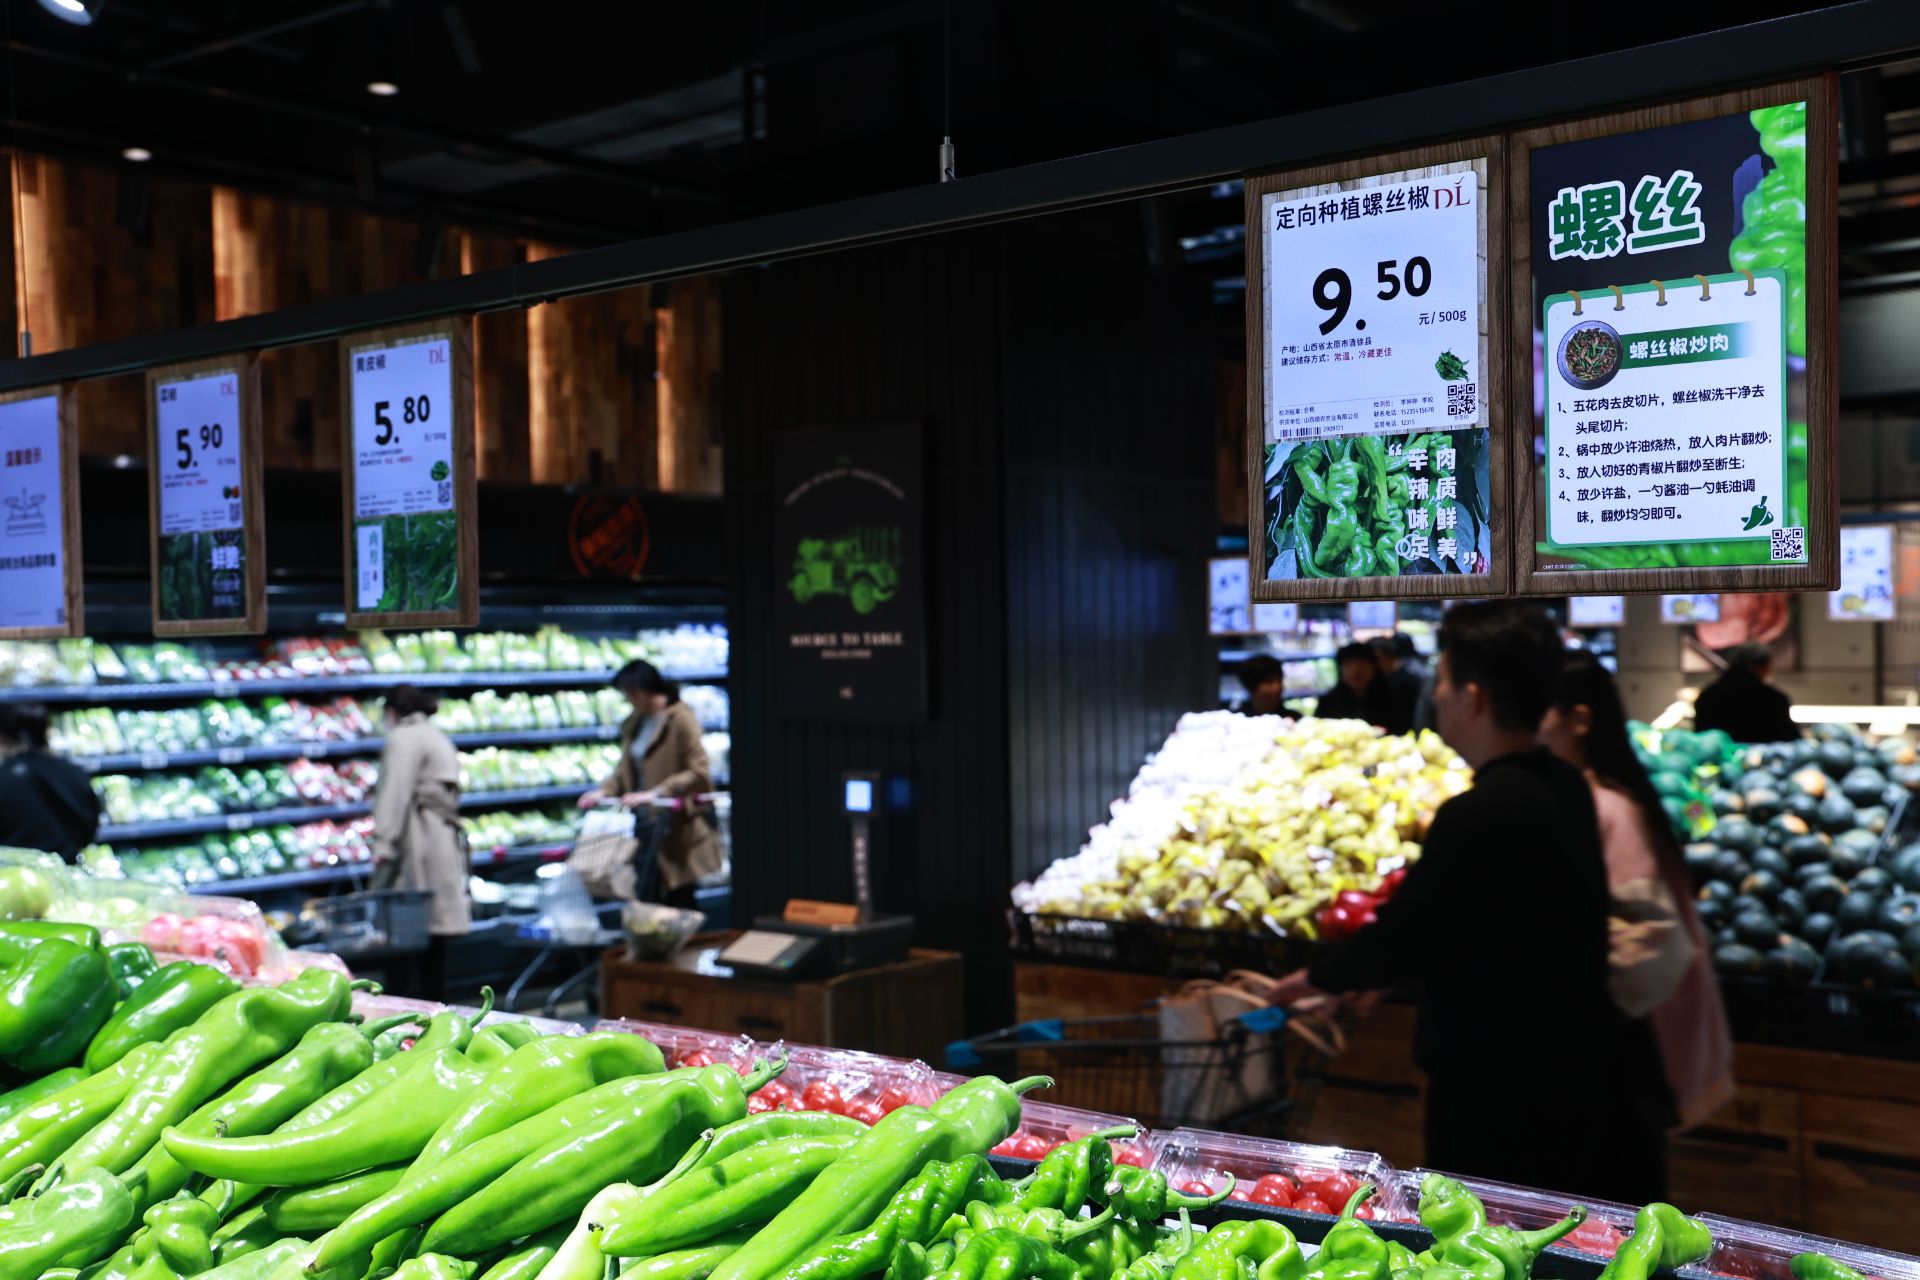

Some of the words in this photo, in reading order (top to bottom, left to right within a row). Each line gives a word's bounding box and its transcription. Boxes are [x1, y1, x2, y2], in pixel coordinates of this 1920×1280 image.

[1276, 186, 1429, 230] 定向种植螺丝椒
[1549, 170, 1705, 260] 螺丝
[1630, 333, 1729, 359] 螺丝椒炒肉
[1576, 506, 1683, 524] 味，翻炒均匀即可。
